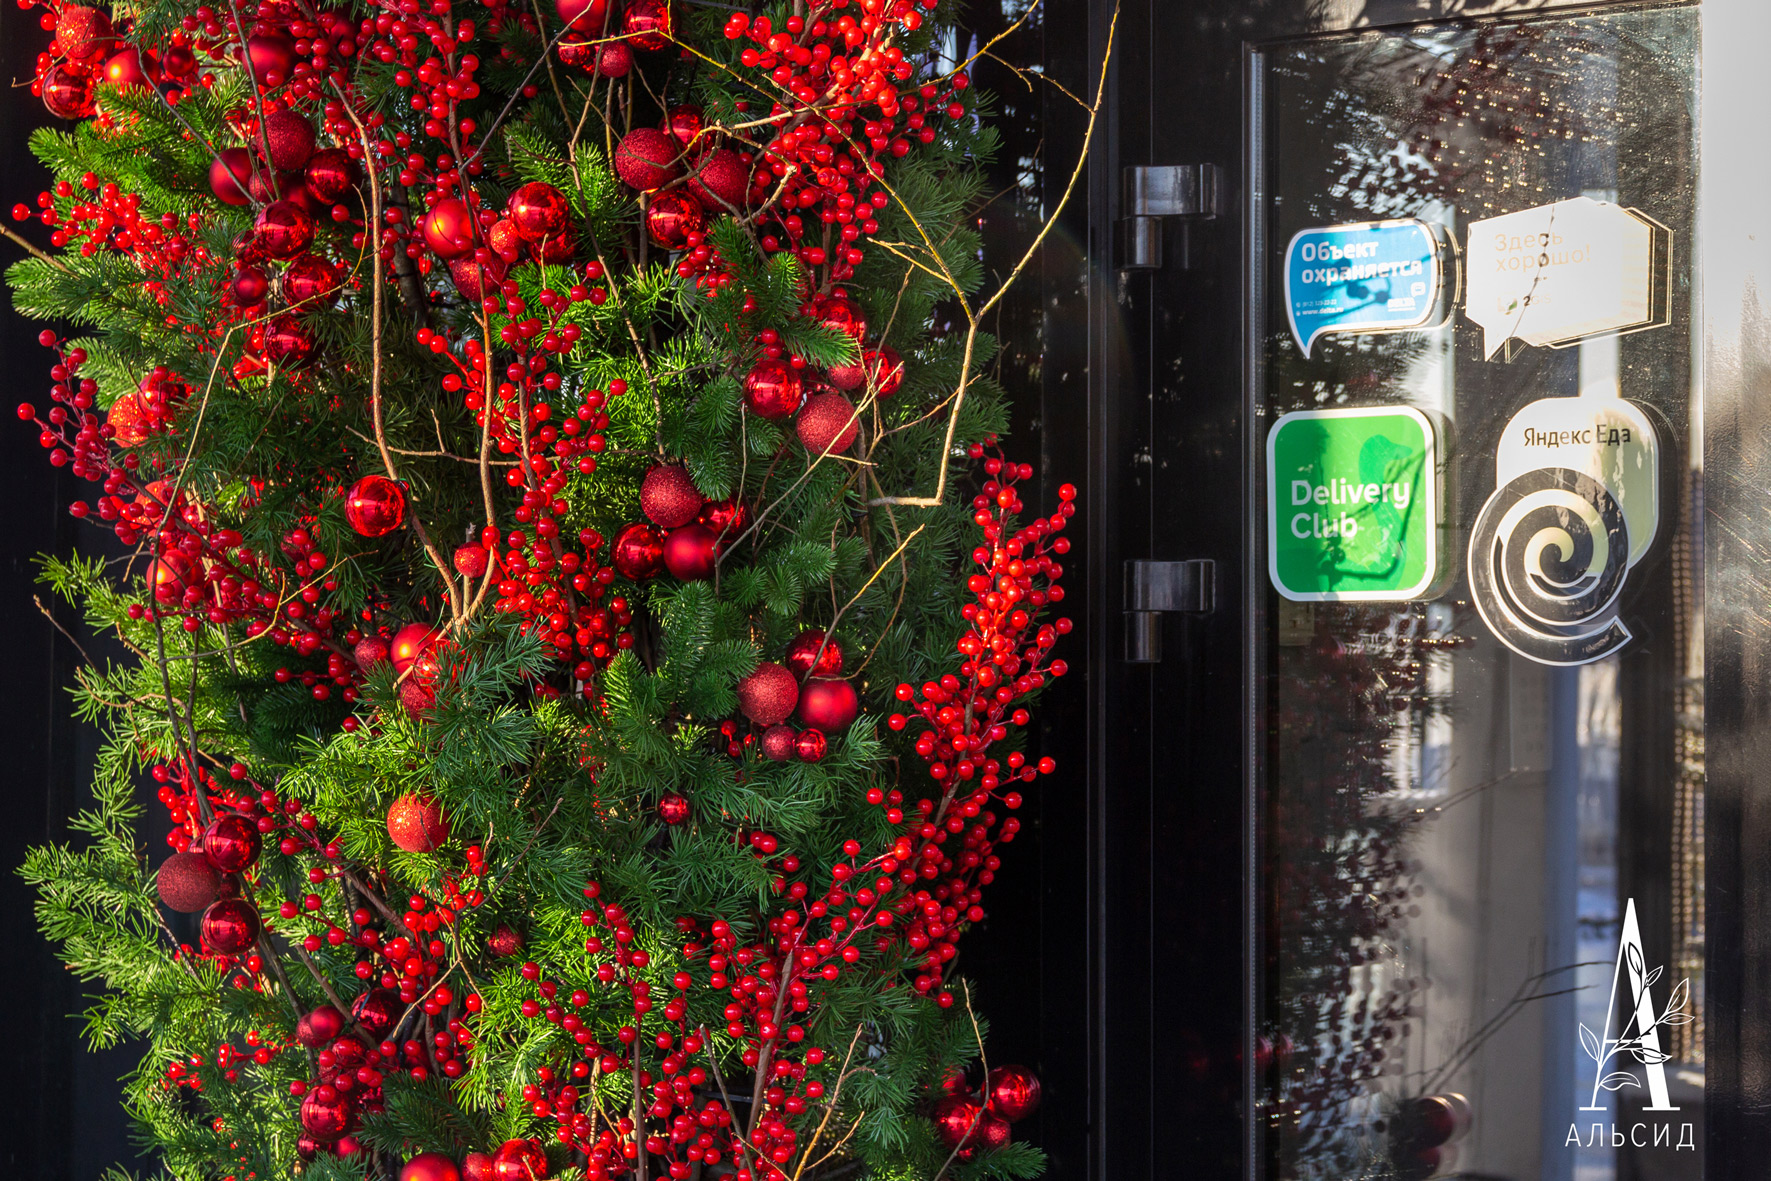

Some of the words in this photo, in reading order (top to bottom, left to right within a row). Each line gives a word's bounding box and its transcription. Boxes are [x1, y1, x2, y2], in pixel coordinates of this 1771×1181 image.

[1301, 241, 1379, 262] Объект
[1495, 232, 1563, 253] Здесь
[1496, 244, 1591, 272] хорошо!
[1301, 260, 1423, 286] охраняется
[1524, 427, 1591, 448] Яндекс
[1596, 424, 1631, 446] Еда
[1291, 477, 1410, 509] Delivery
[1291, 512, 1358, 539] Club
